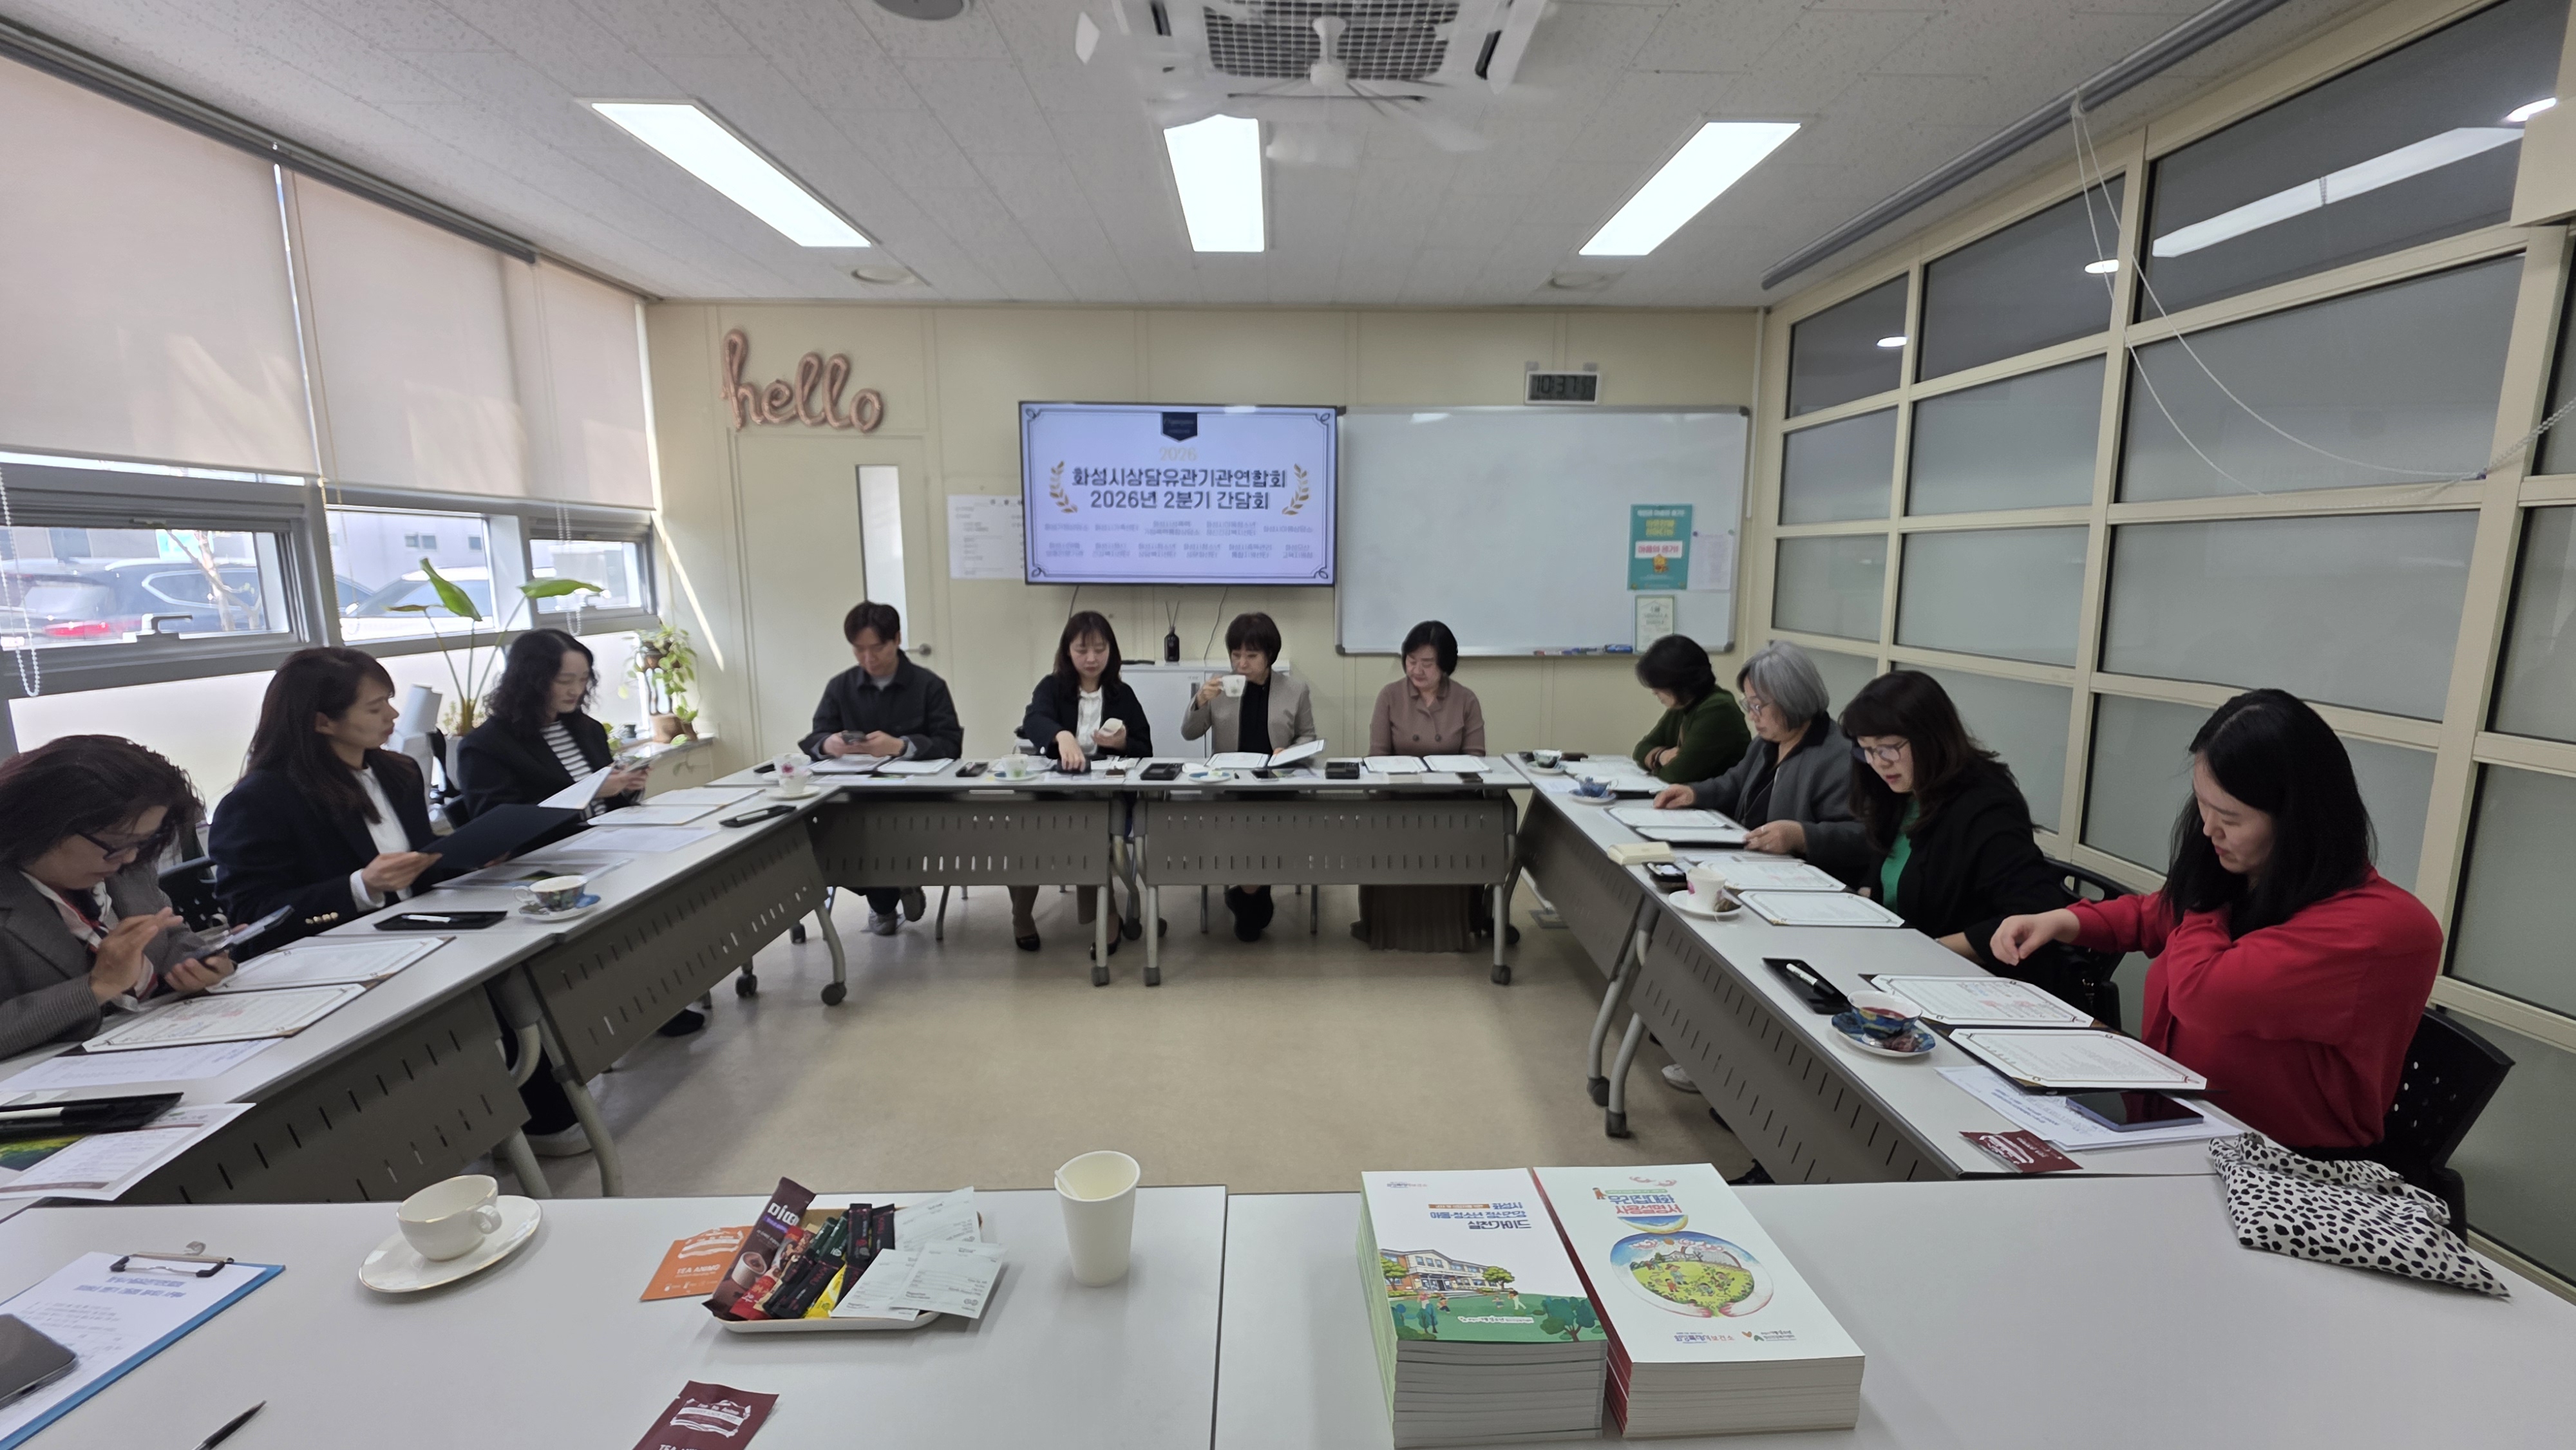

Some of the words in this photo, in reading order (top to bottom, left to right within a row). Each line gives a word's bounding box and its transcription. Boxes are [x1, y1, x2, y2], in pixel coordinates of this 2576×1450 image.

[721, 327, 885, 433] hello
[1159, 446, 1197, 461] 2026
[1072, 467, 1287, 488] 화성시상담유관기관연합회
[1090, 491, 1157, 509] 2026년
[1164, 491, 1211, 509] 2분기
[1217, 492, 1269, 510] 간담회
[1492, 1201, 1523, 1210] 화성시
[1608, 1194, 1676, 1205] 우리집대화
[1615, 1204, 1683, 1214] 사용설명서
